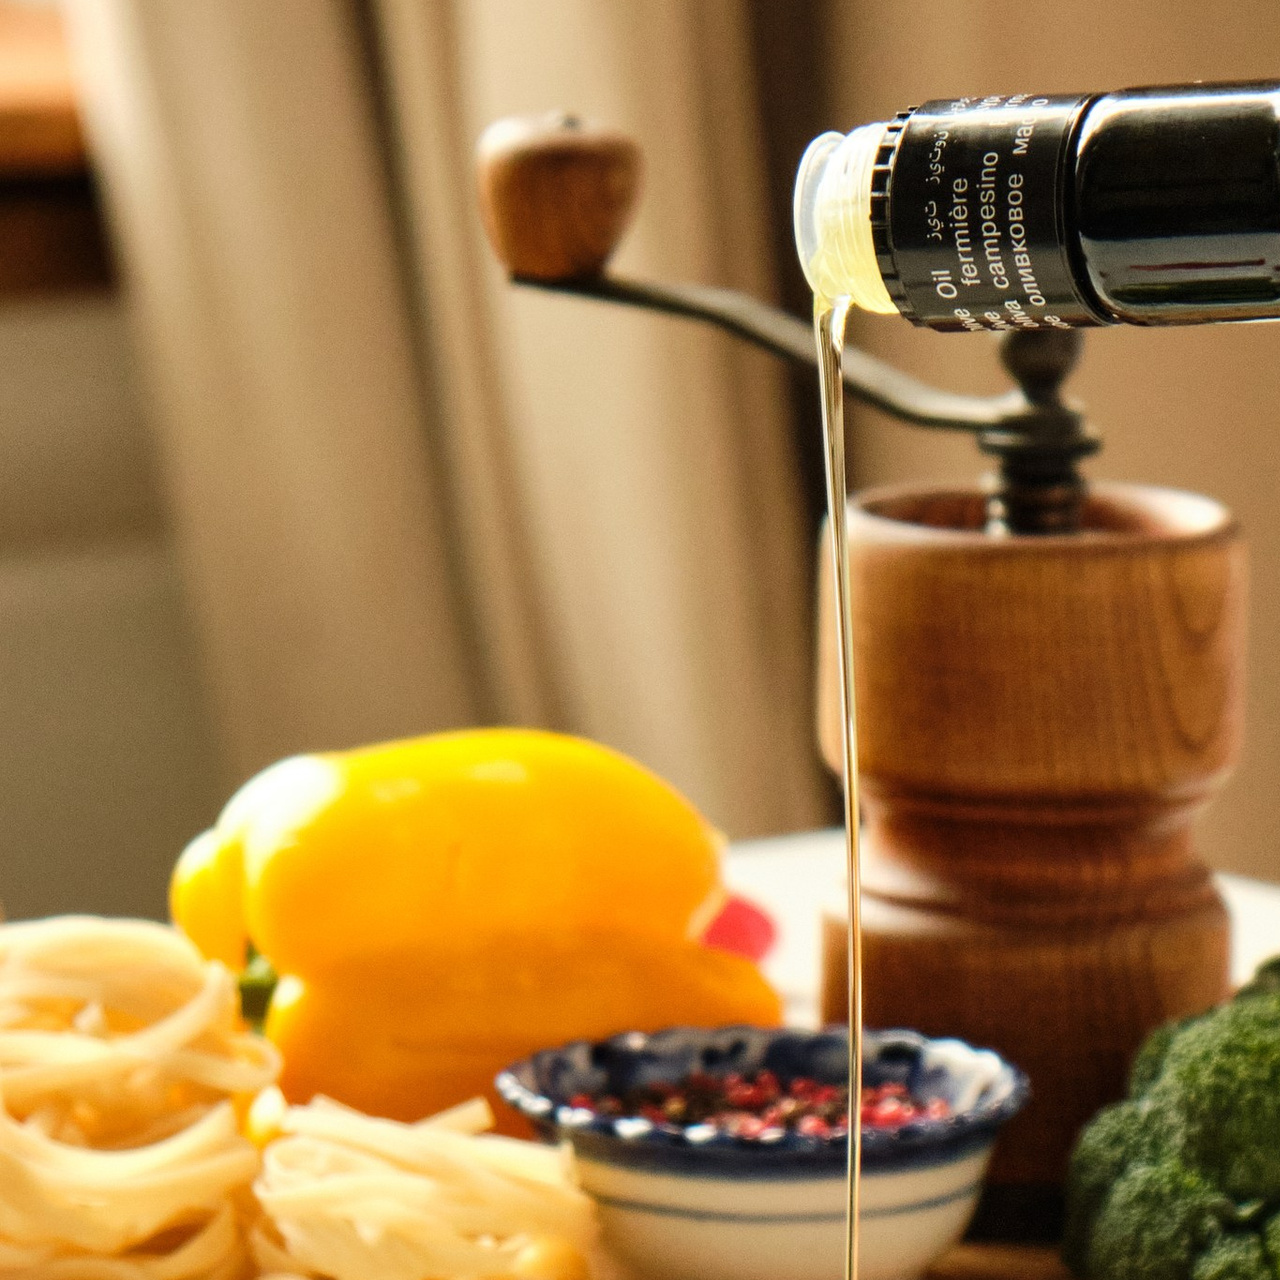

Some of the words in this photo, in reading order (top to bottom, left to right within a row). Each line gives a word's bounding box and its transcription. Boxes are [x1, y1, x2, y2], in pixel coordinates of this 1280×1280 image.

[1012, 98, 1049, 155] масо
[949, 178, 981, 286] fermière
[976, 152, 1009, 289] campesino
[1007, 173, 1046, 306] оливковое
[931, 270, 958, 299] Oil
